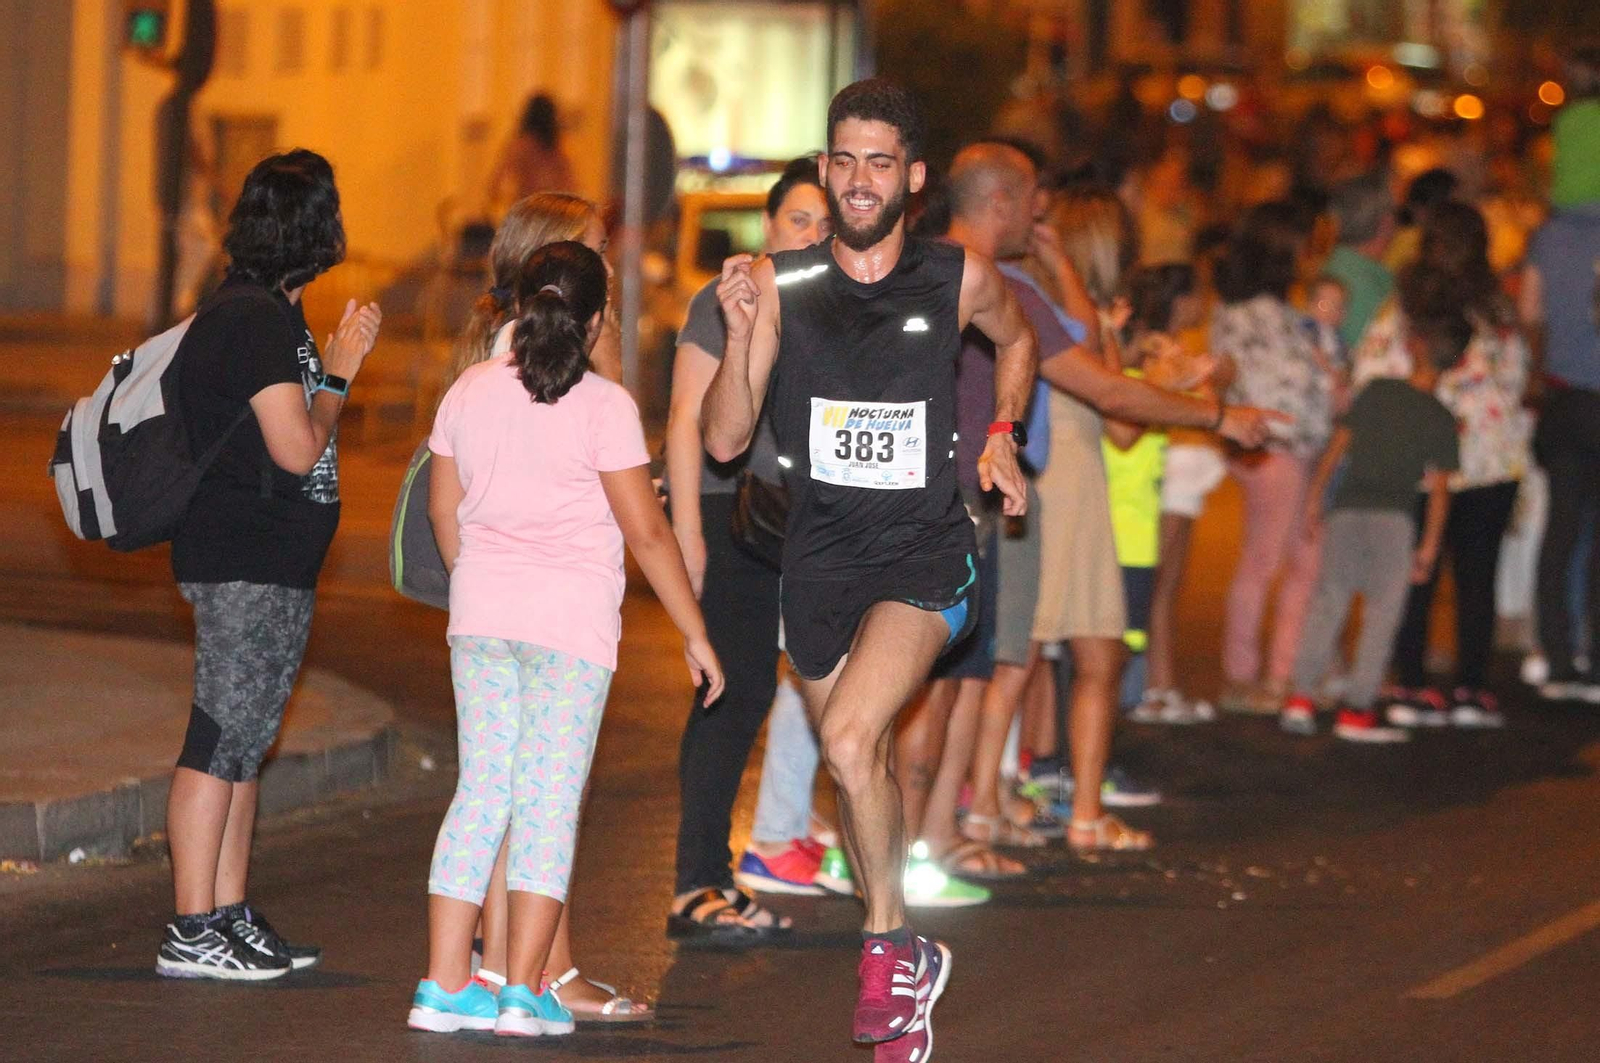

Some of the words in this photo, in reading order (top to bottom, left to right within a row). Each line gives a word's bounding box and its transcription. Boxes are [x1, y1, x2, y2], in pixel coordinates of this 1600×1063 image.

[823, 406, 849, 429] VII
[848, 407, 915, 420] NOCTURNA
[844, 418, 862, 429] DE
[865, 419, 912, 432] HUELVA
[834, 430, 894, 463] 383
[848, 461, 864, 469] JUAN
